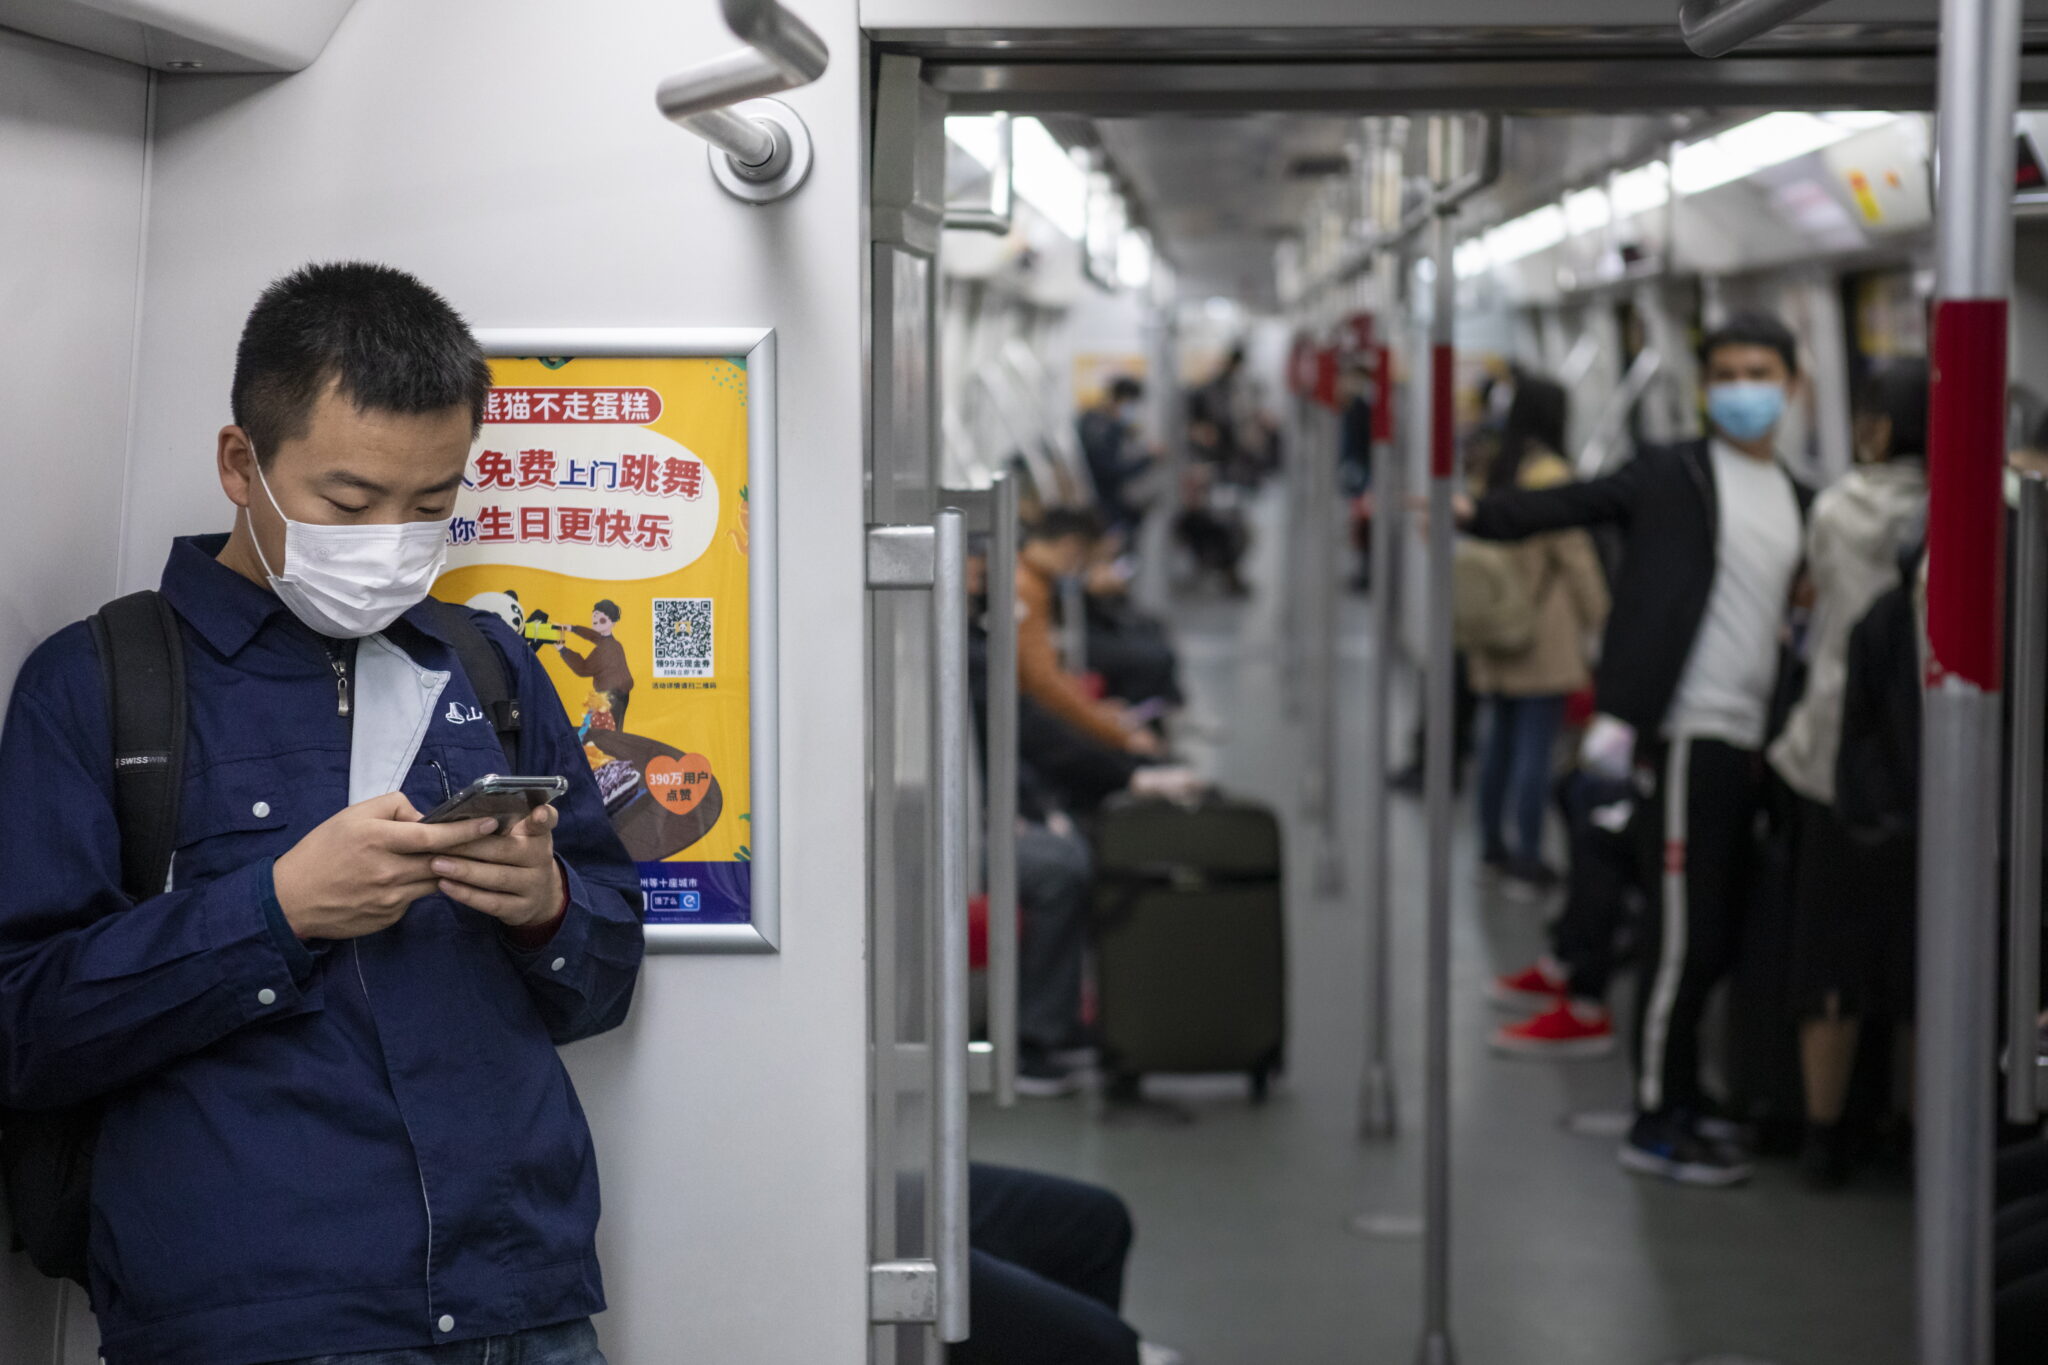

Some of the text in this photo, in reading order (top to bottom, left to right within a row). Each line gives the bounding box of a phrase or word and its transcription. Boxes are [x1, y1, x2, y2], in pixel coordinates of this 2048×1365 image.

[463, 449, 702, 498] 免费上门跳舞
[446, 506, 671, 549] 你生日更快乐
[649, 771, 708, 786] 390万用户
[666, 788, 692, 802] 点赞
